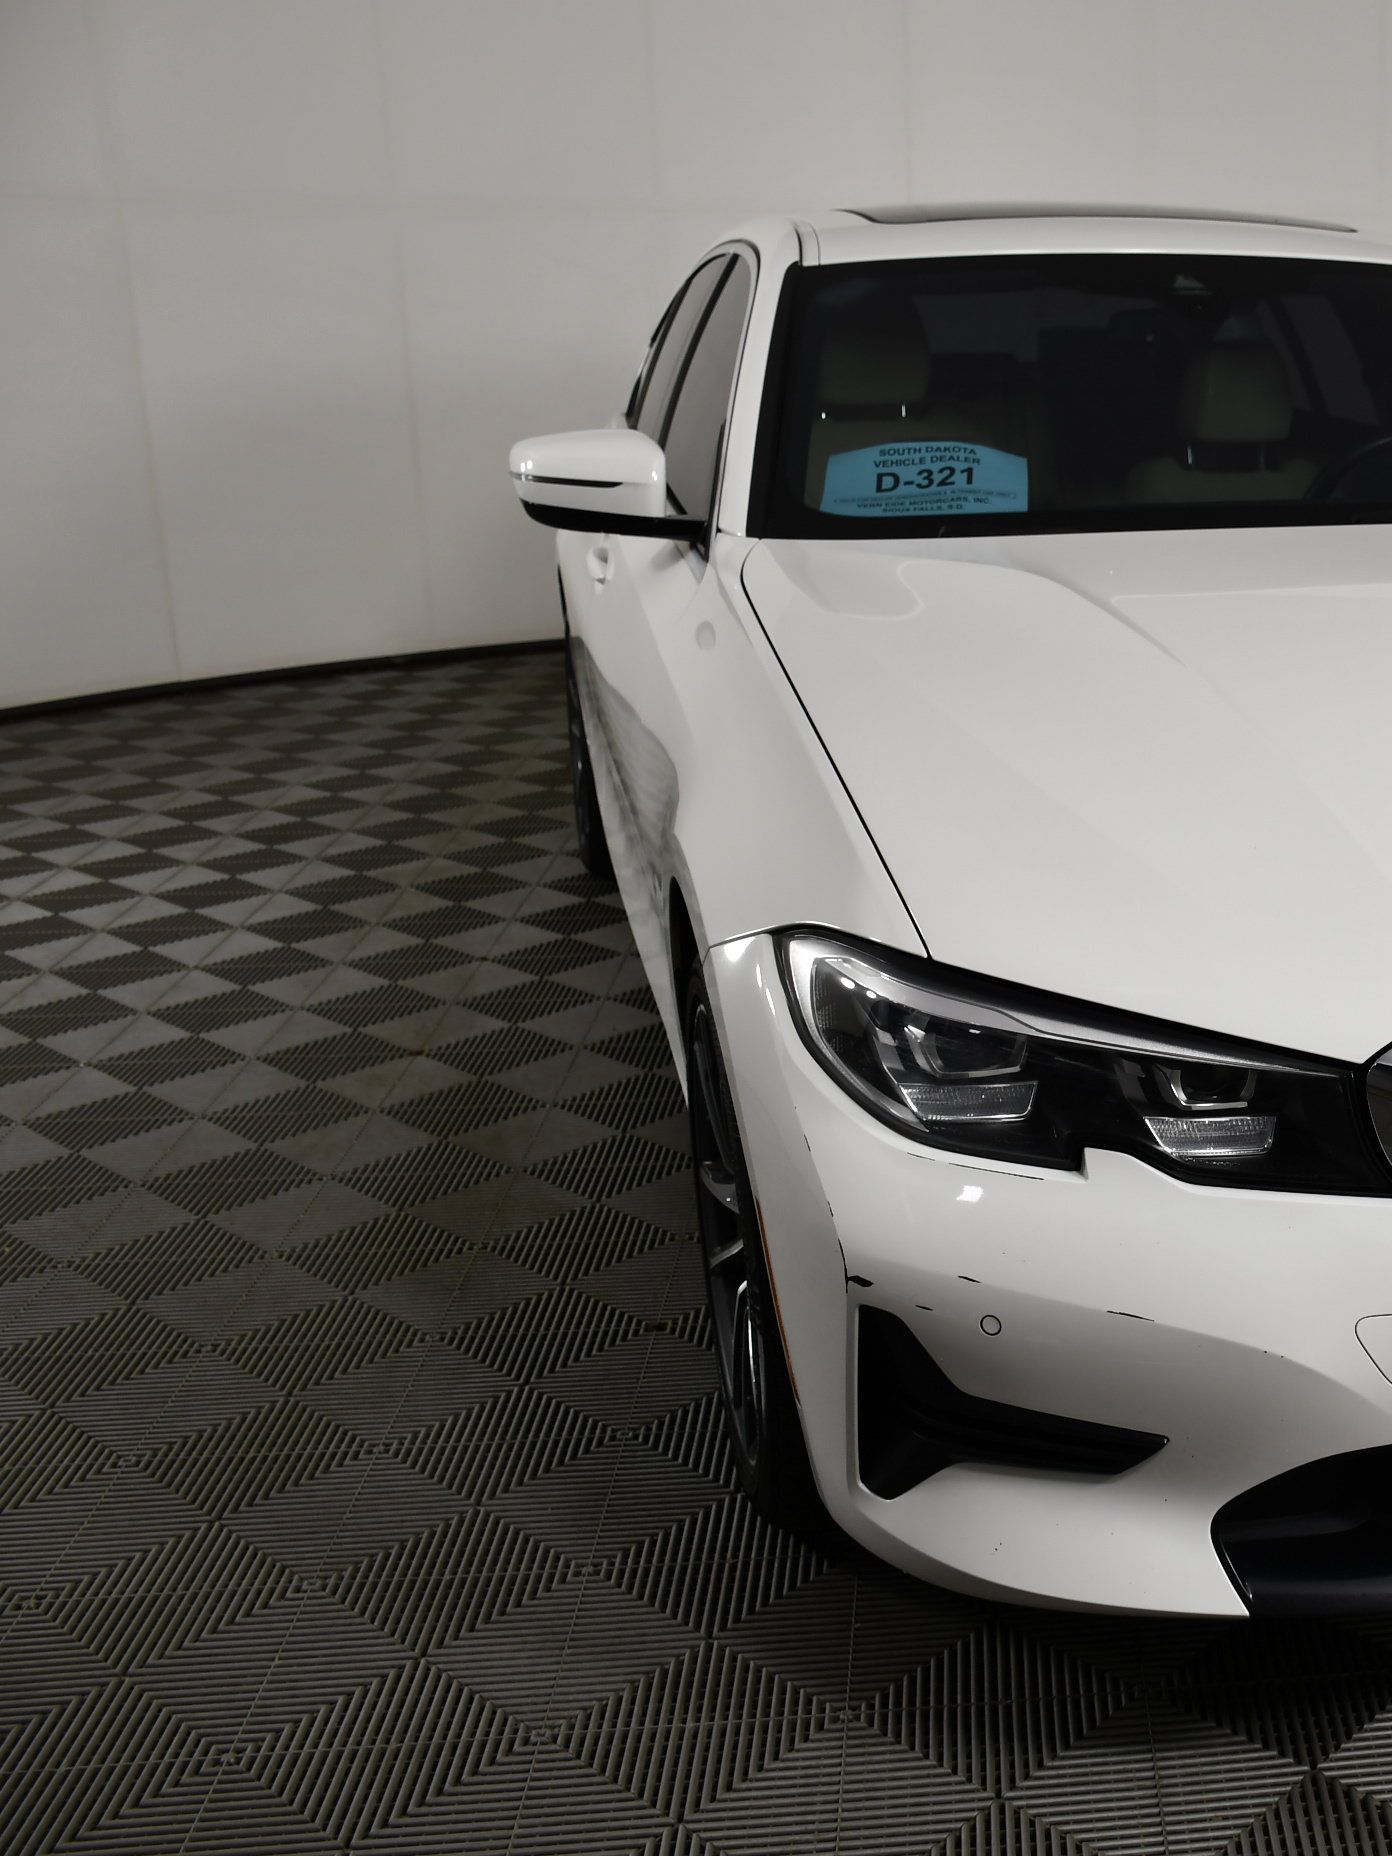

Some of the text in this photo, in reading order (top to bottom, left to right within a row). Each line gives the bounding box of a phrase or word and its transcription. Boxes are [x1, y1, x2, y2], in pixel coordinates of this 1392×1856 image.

[879, 446, 977, 457] SOUTH DAKOTA
[873, 455, 981, 468] VEHICLE DEALER
[875, 466, 974, 493] D-321
